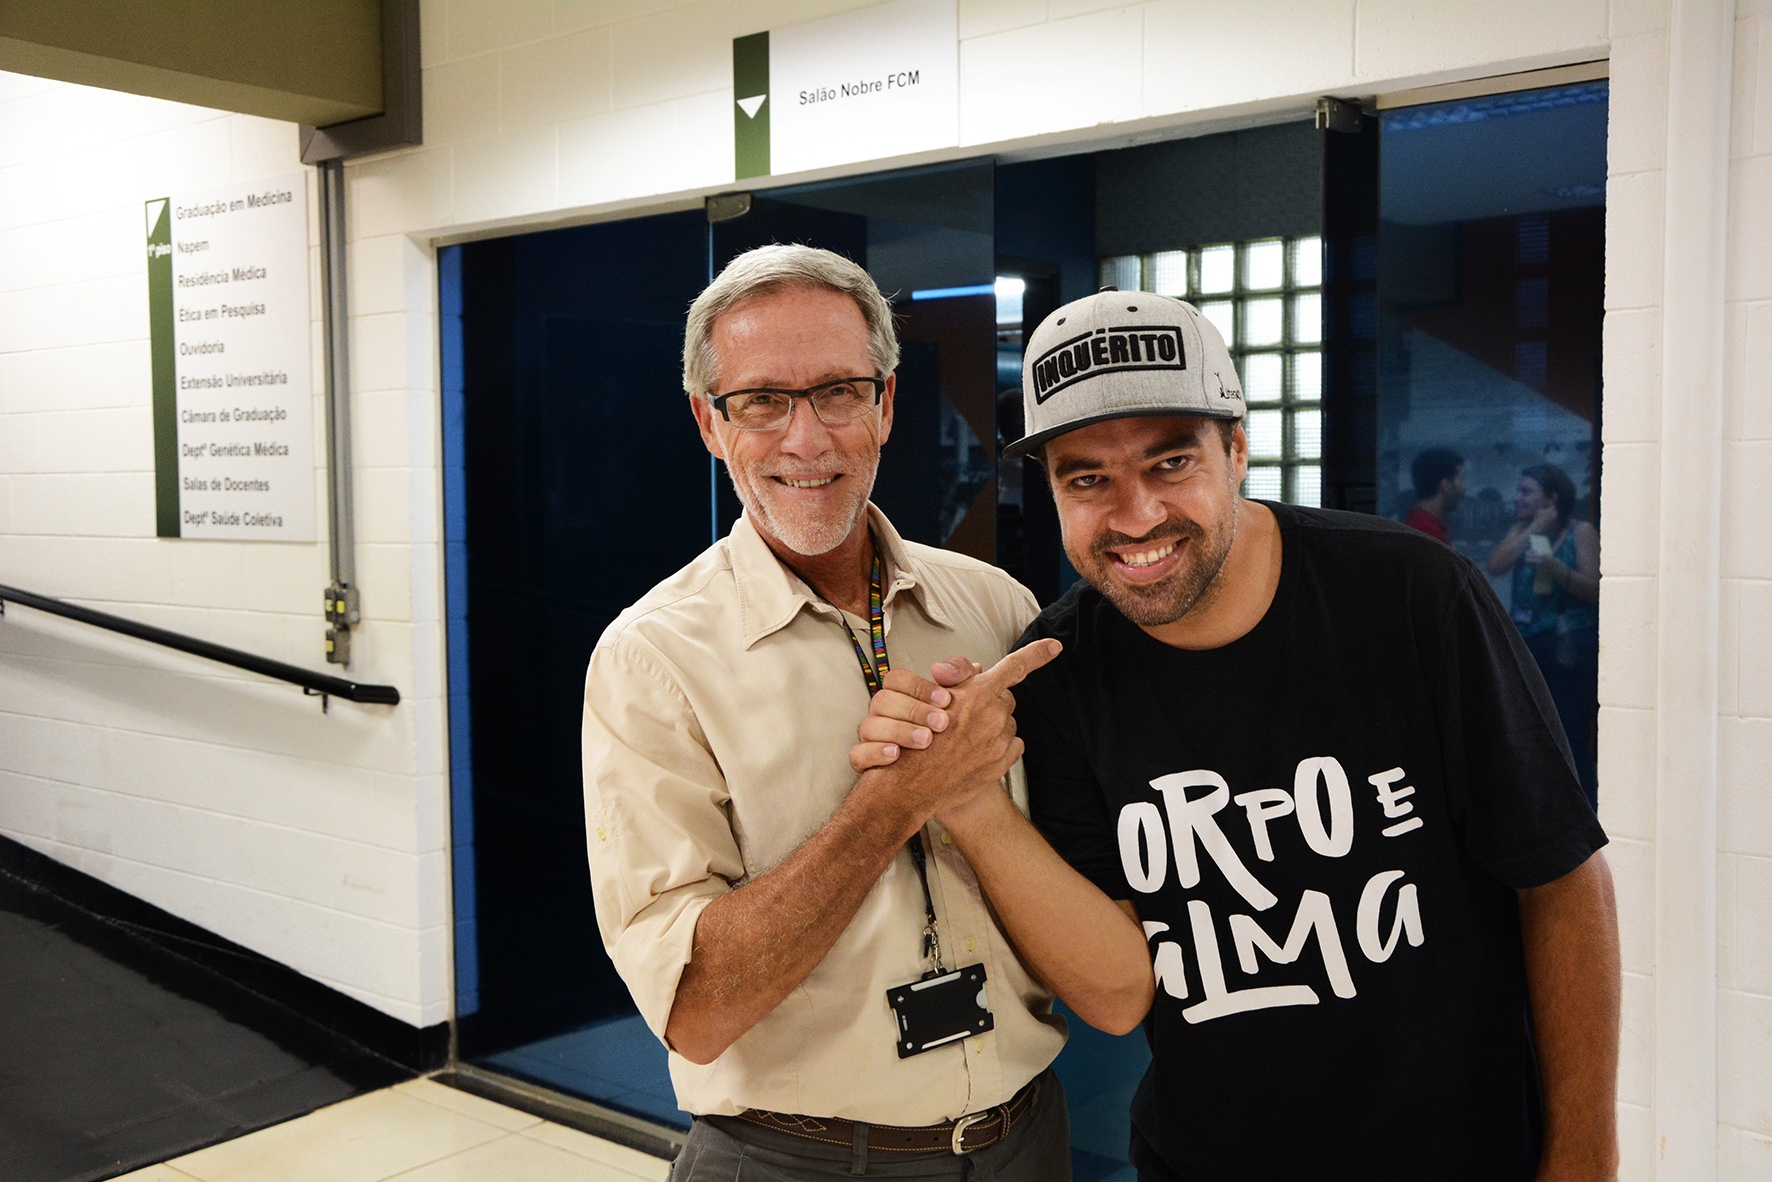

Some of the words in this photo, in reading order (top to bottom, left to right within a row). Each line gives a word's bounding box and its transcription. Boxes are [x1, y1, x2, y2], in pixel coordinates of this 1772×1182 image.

[799, 87, 836, 105] Salão
[840, 80, 882, 98] Nobre
[887, 70, 920, 89] FCM
[176, 200, 228, 219] Graduação
[229, 199, 245, 212] em
[247, 190, 292, 209] Medicina
[177, 240, 210, 256] Napem
[178, 270, 229, 288] Residência
[232, 265, 267, 282] Médica
[204, 307, 218, 320] em
[221, 301, 266, 319] Pesquisa
[180, 340, 225, 356] Ouvidoria
[181, 374, 224, 390] Extensão
[225, 370, 288, 388] Universitária
[181, 409, 217, 423] Câmara
[219, 408, 230, 422] de
[233, 406, 287, 424] Graduação
[209, 442, 251, 457] Genética
[254, 442, 289, 456] Médica
[183, 477, 208, 491] Salas
[210, 477, 221, 491] de
[224, 477, 270, 492] Docentes
[211, 511, 240, 526] Saúde
[243, 512, 284, 527] Coletiva
[1368, 767, 1424, 837] E
